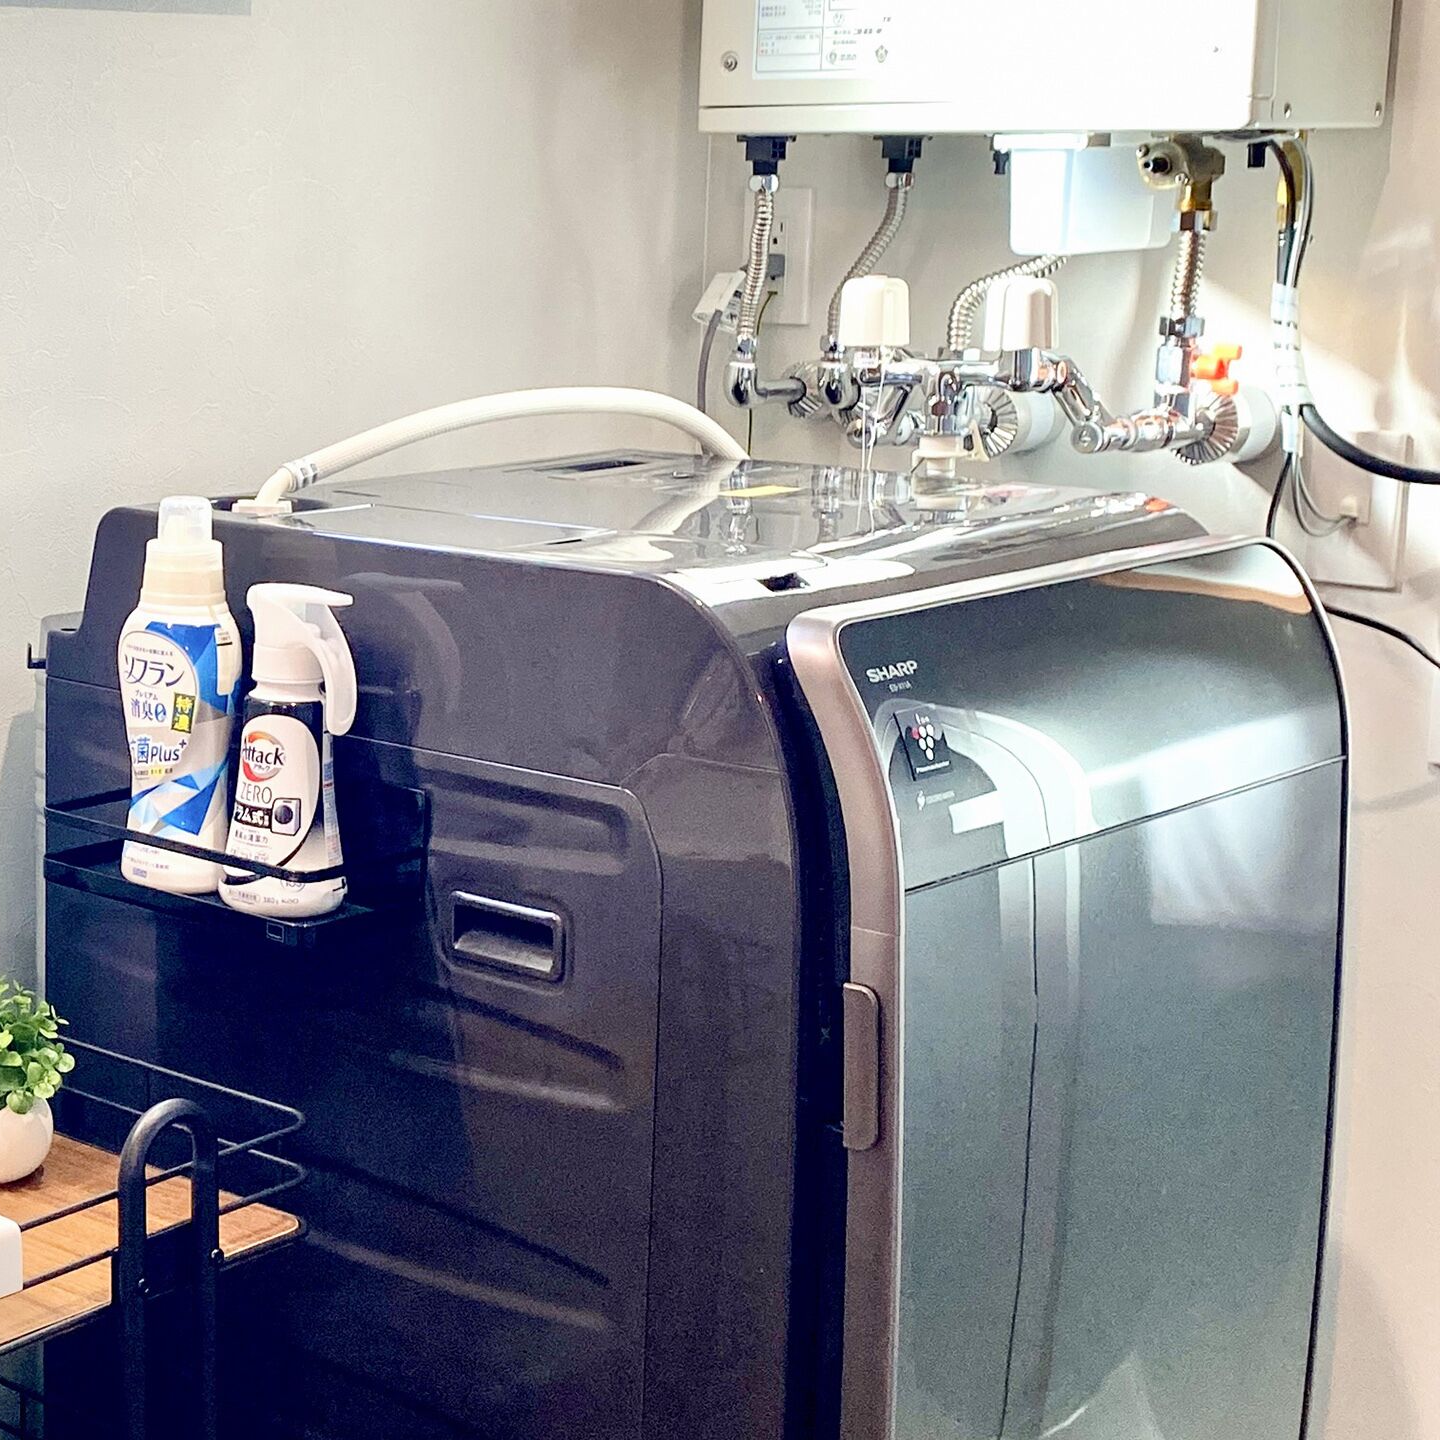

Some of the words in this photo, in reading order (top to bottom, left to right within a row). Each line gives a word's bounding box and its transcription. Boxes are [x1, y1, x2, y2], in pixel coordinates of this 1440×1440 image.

[124, 654, 185, 688] ソフラン
[866, 660, 918, 683] SHARP
[242, 736, 285, 766] Attack
[240, 781, 273, 805] ZERO
